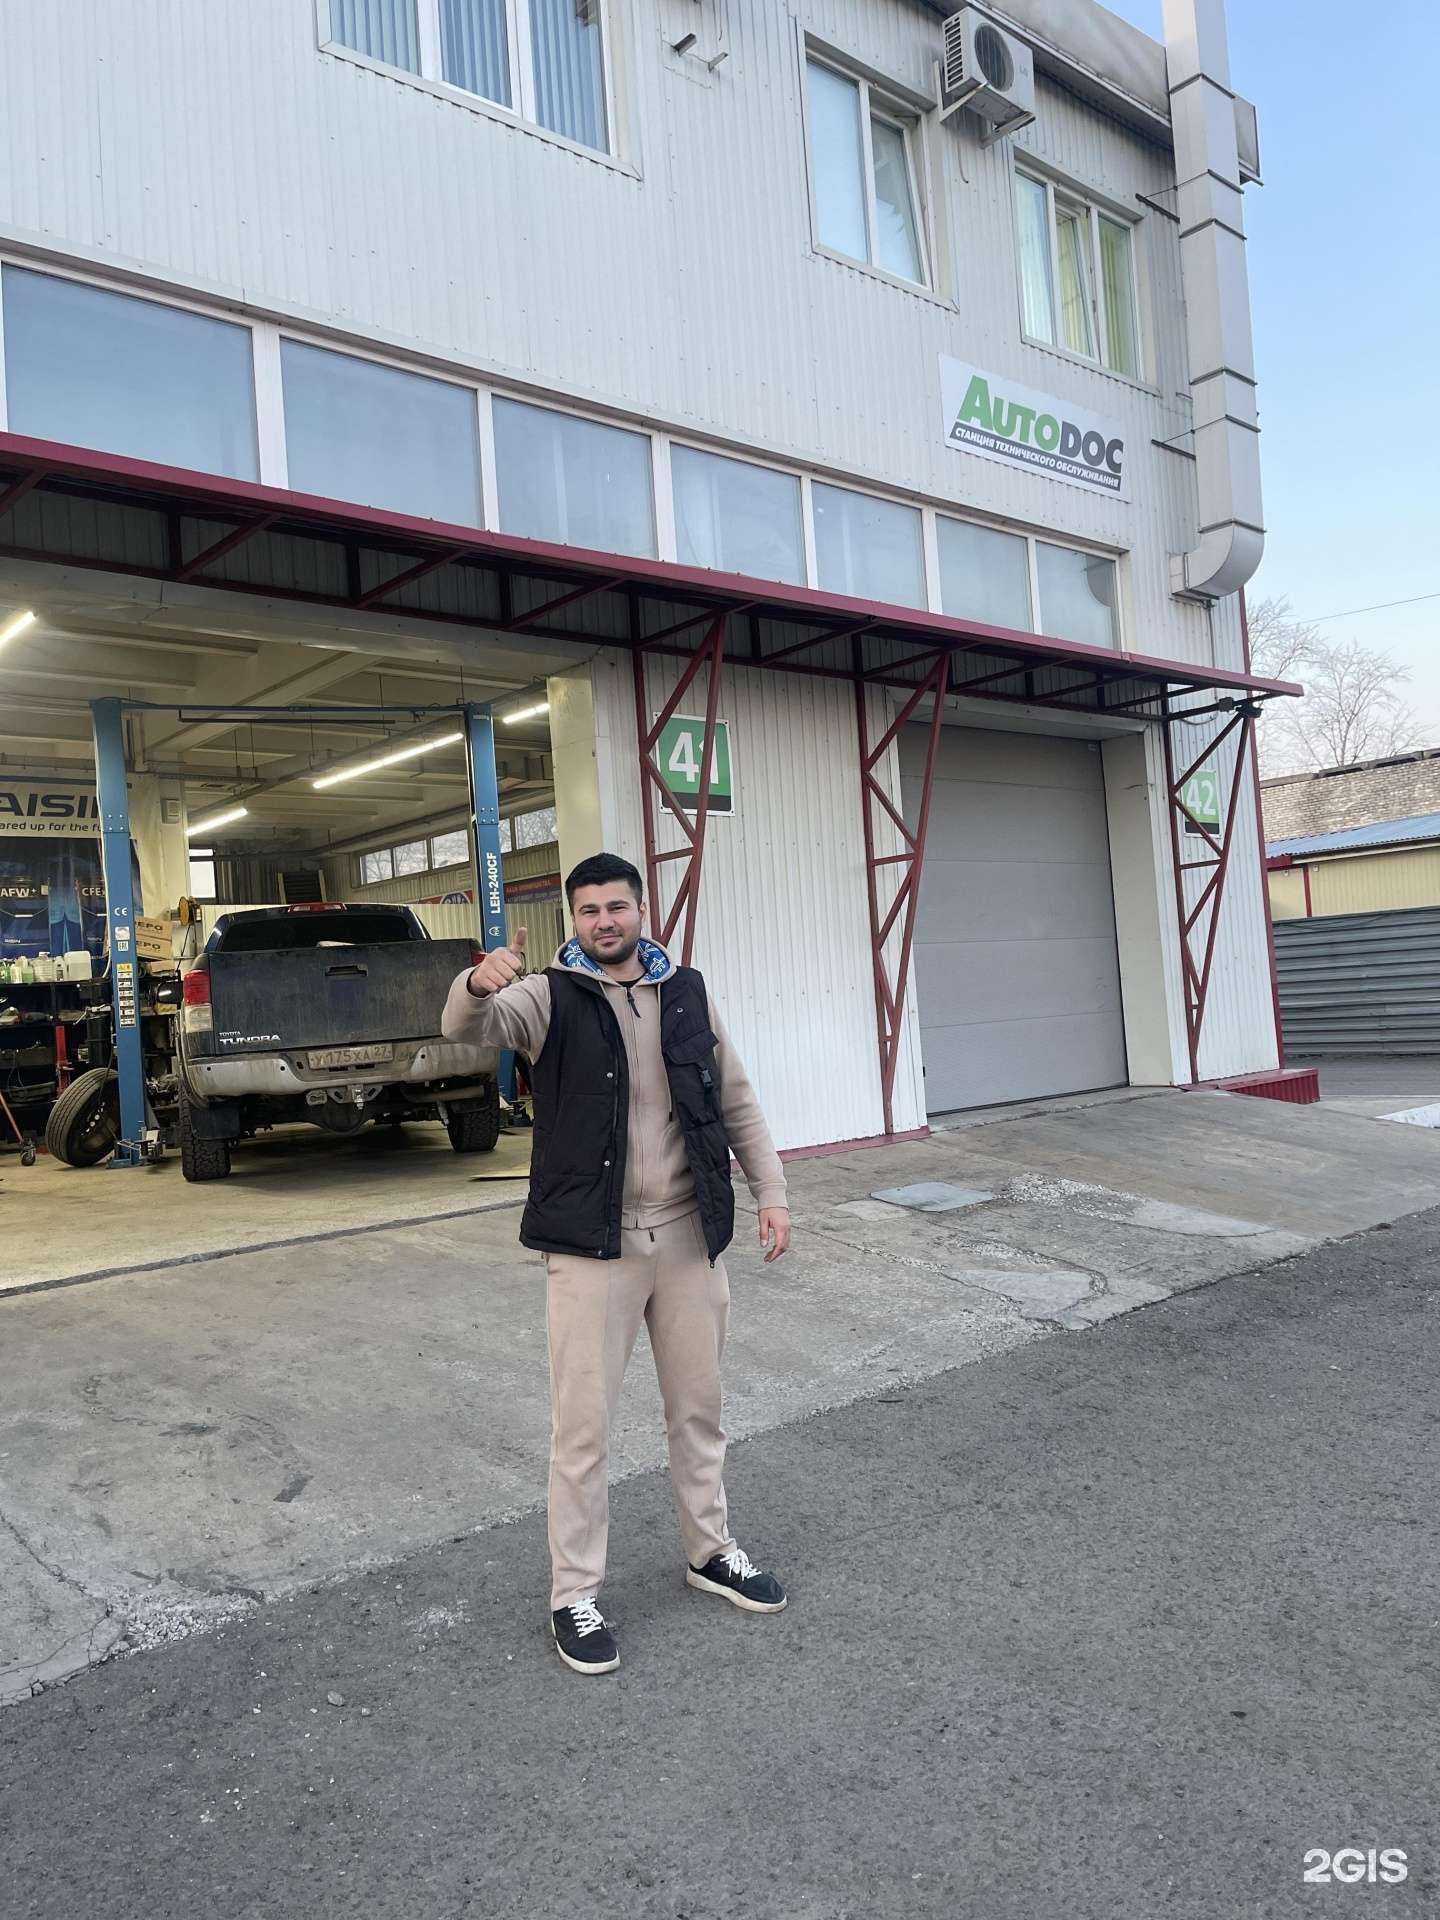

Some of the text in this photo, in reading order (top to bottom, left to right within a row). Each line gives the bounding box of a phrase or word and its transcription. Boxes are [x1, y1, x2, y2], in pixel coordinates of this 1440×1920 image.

[955, 427, 1120, 488] СТАНЦИЯ ТЕХНИЧЕСКОГО ОБСЛУЖИВАНИЯ
[669, 732, 719, 785] 41
[1186, 780, 1216, 816] 42
[30, 823, 45, 831] up
[49, 823, 66, 831] for
[70, 823, 89, 832] the
[487, 852, 501, 914] LEH-240CF
[114, 907, 128, 917] CE
[135, 921, 163, 931] EPO
[219, 1034, 281, 1046] TUNDRA
